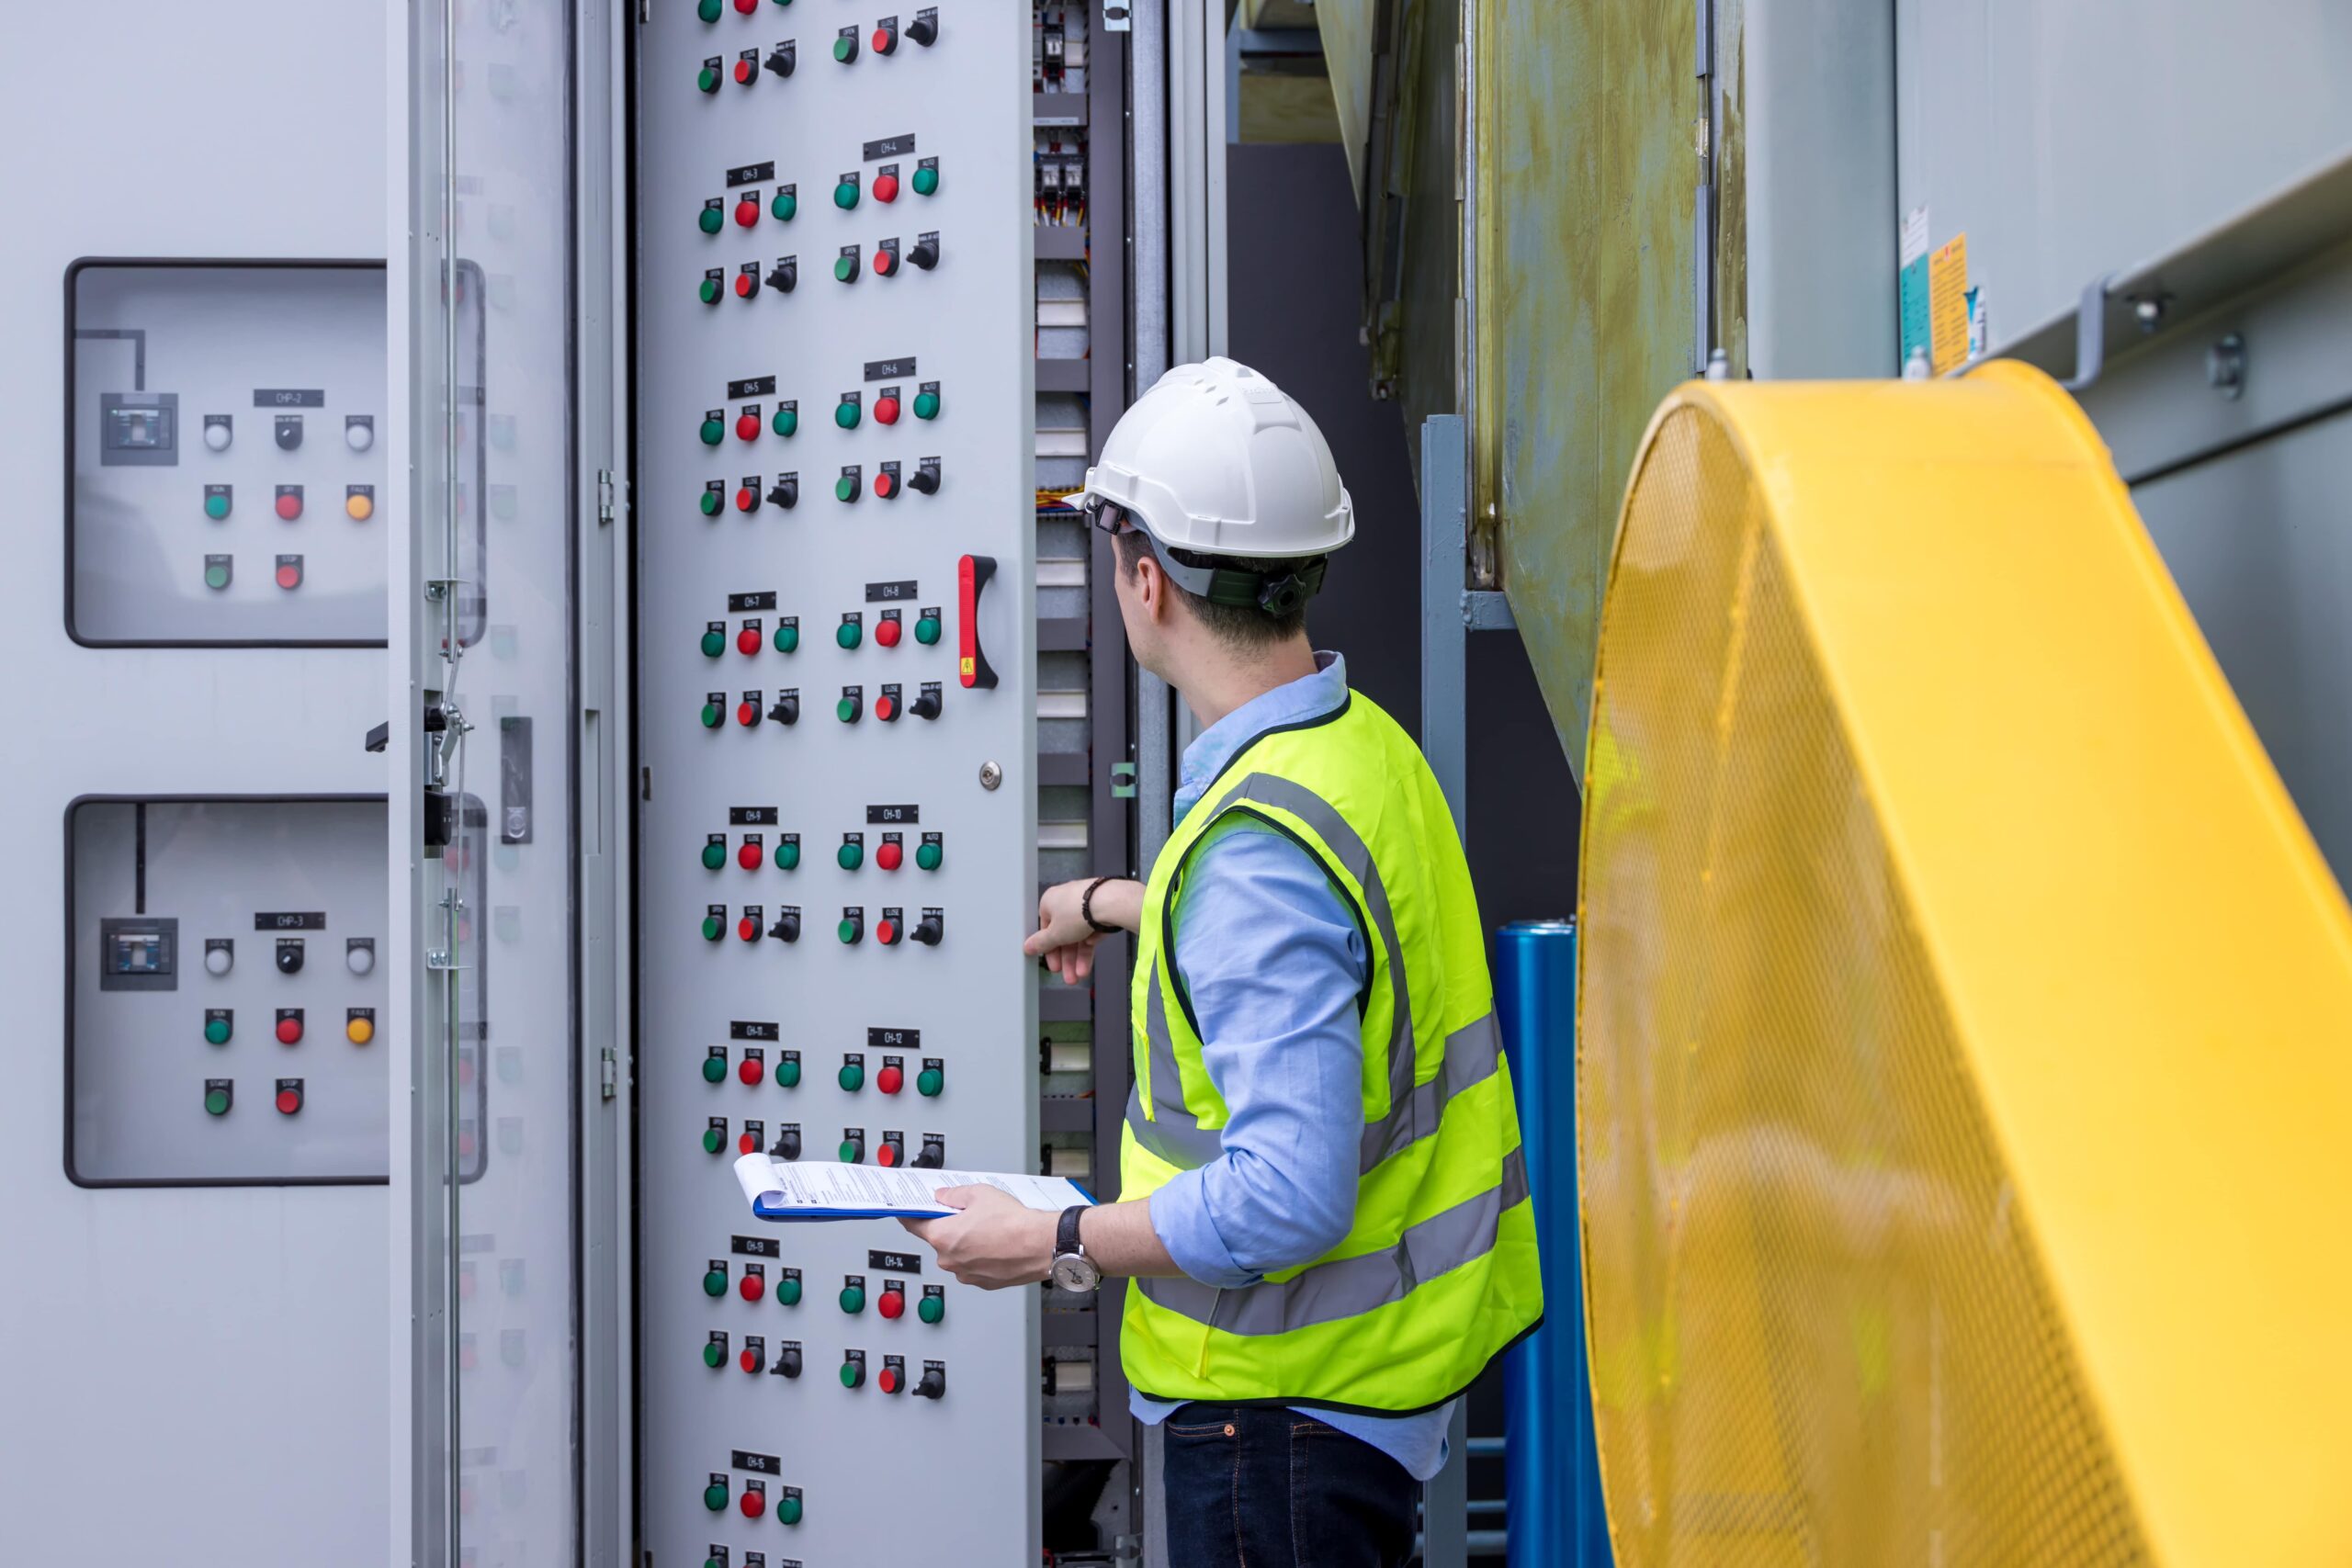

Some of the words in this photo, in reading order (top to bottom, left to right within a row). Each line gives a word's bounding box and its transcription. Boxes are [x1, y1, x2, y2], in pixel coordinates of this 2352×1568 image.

[881, 142, 897, 153] CH-4
[742, 169, 758, 180] CH-3
[882, 364, 897, 375] CH-6
[744, 382, 759, 393] CH-5
[277, 393, 300, 404] CHP-2
[883, 586, 899, 596] CH-8
[744, 596, 760, 607] CH-7
[746, 810, 761, 821] CH-9
[884, 809, 901, 819] CH-10
[277, 916, 303, 926] CHP-3
[746, 1025, 763, 1036] CH-11
[884, 1032, 902, 1043] CH-12
[746, 1241, 763, 1252] CH-13
[885, 1256, 903, 1268] CH-14
[748, 1457, 764, 1469] CH-15
